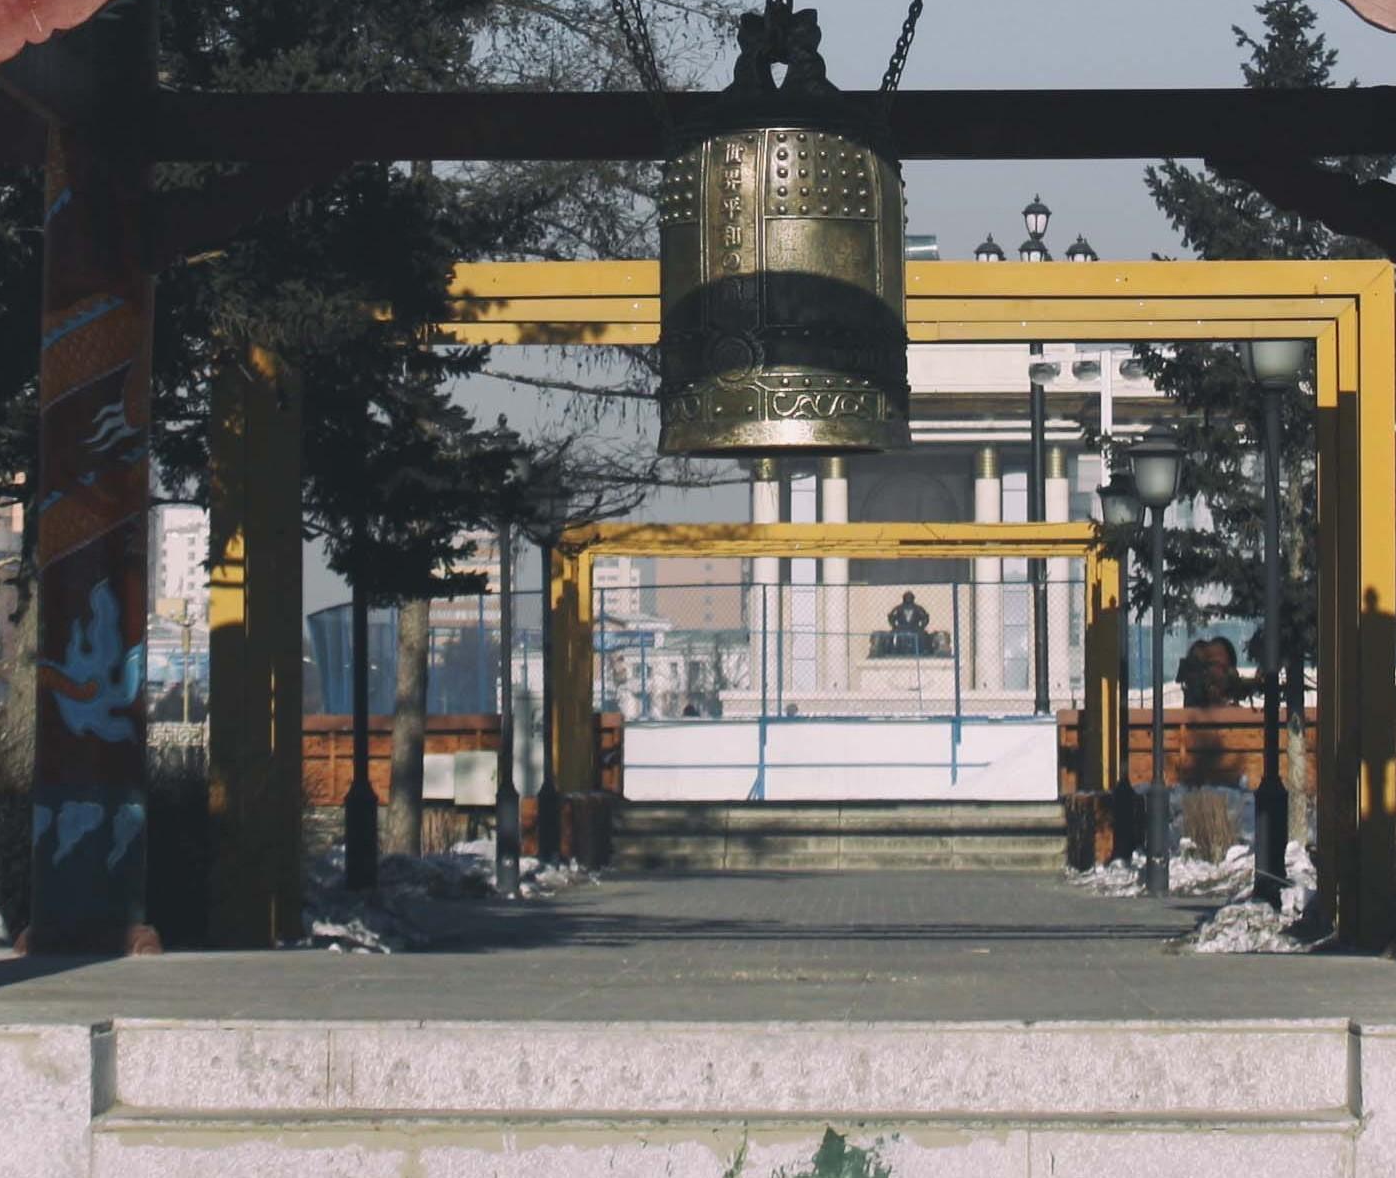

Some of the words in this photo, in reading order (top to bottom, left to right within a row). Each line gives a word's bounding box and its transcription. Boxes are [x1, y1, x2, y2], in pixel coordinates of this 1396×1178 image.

[723, 142, 746, 302] 世界平和の
